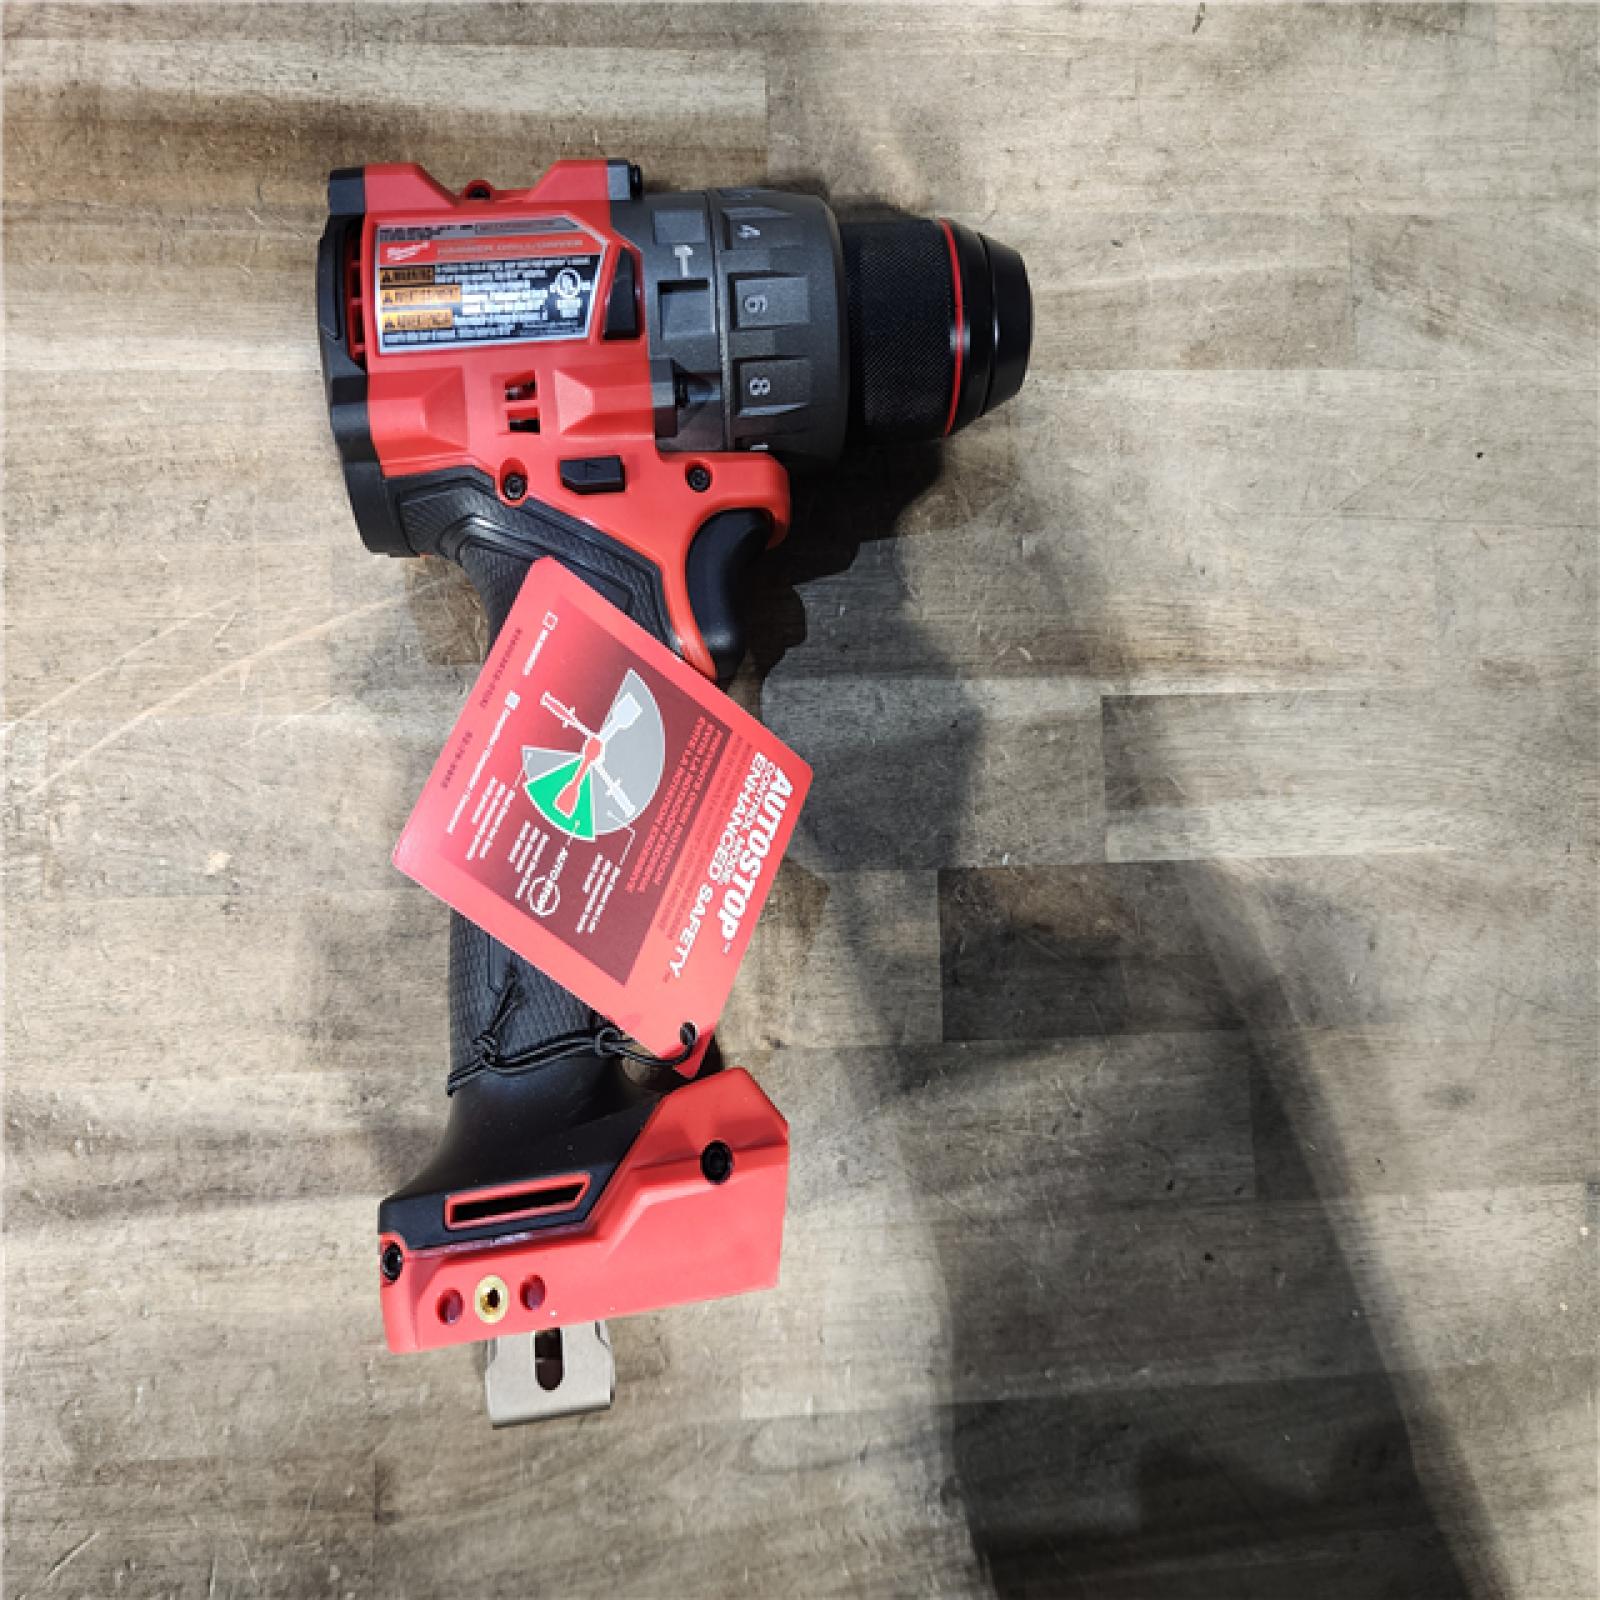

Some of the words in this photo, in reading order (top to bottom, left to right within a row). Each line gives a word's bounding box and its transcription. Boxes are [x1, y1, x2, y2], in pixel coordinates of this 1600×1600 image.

[738, 223, 761, 240] 4
[749, 376, 771, 396] 8
[708, 752, 765, 882] ENHANCED
[717, 767, 794, 940] AUTOSTOP
[669, 883, 714, 978] SAFETY
